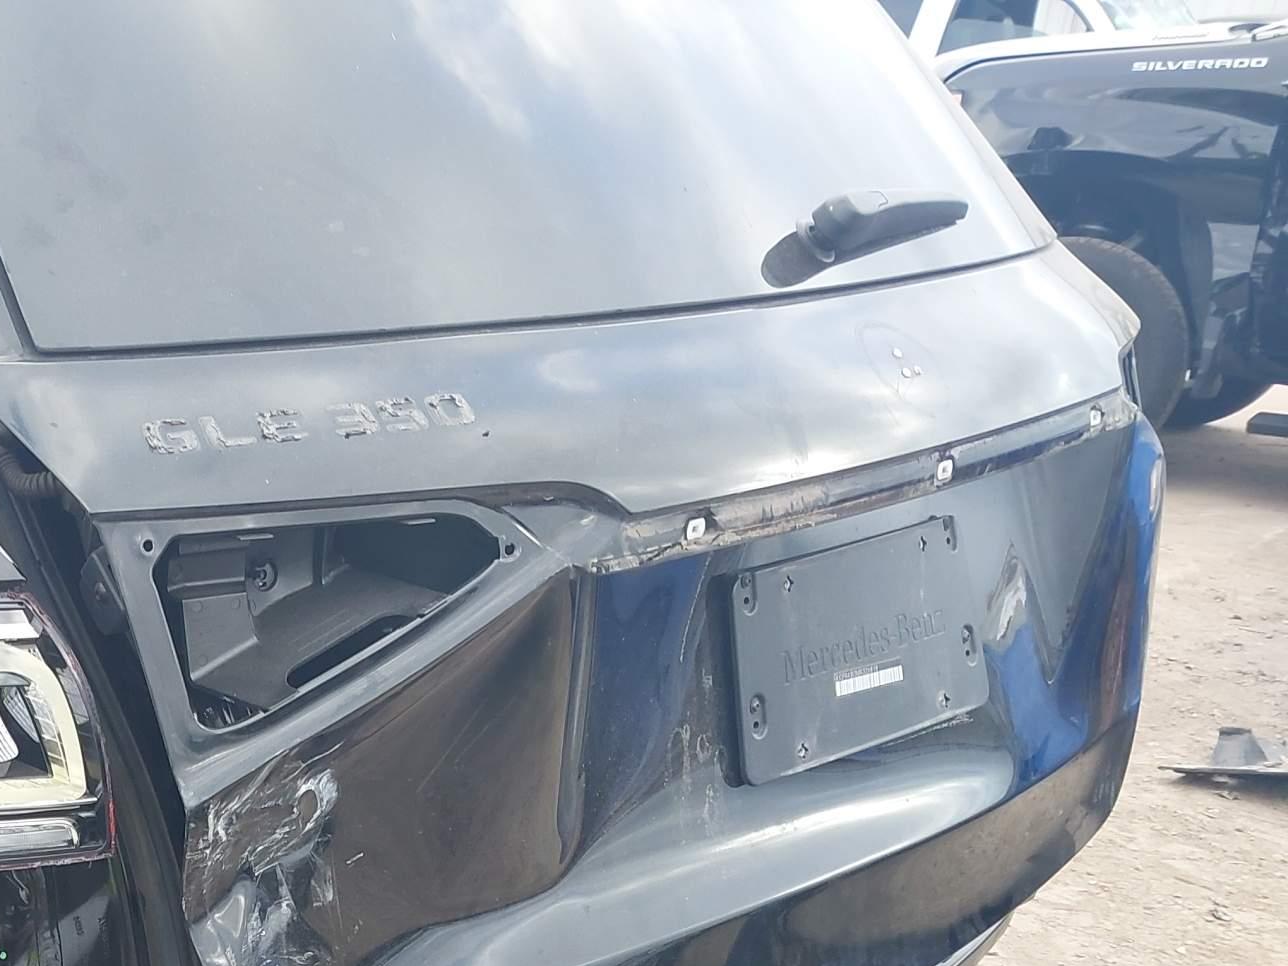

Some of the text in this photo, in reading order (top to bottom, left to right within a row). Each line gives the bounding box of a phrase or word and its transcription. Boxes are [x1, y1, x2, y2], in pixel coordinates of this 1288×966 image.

[1131, 57, 1269, 72] SILVERADO
[141, 391, 477, 455] GLE 350
[782, 609, 946, 685] Mercedes-Benz
